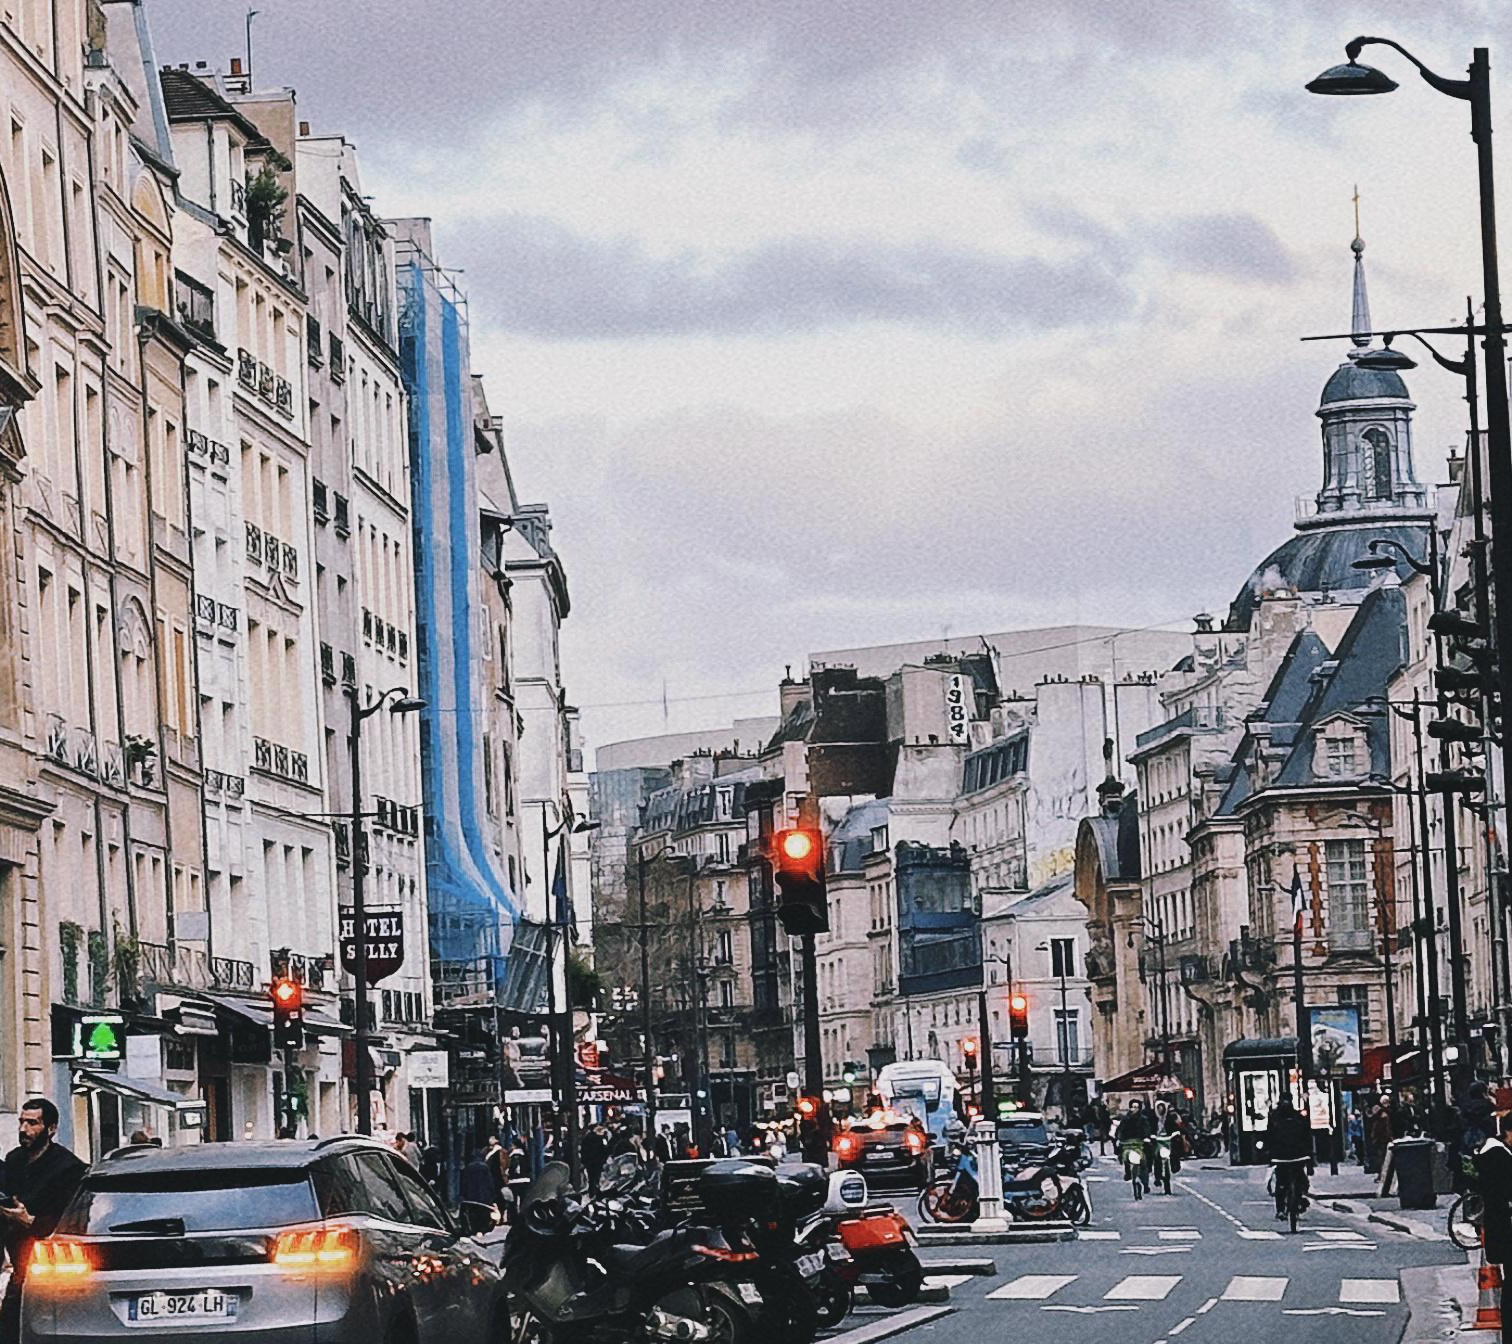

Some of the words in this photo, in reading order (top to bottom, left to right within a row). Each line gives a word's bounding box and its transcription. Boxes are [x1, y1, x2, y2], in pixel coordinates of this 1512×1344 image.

[947, 676, 965, 737] 1984
[341, 918, 402, 938] HTEL
[346, 943, 399, 960] SLLY
